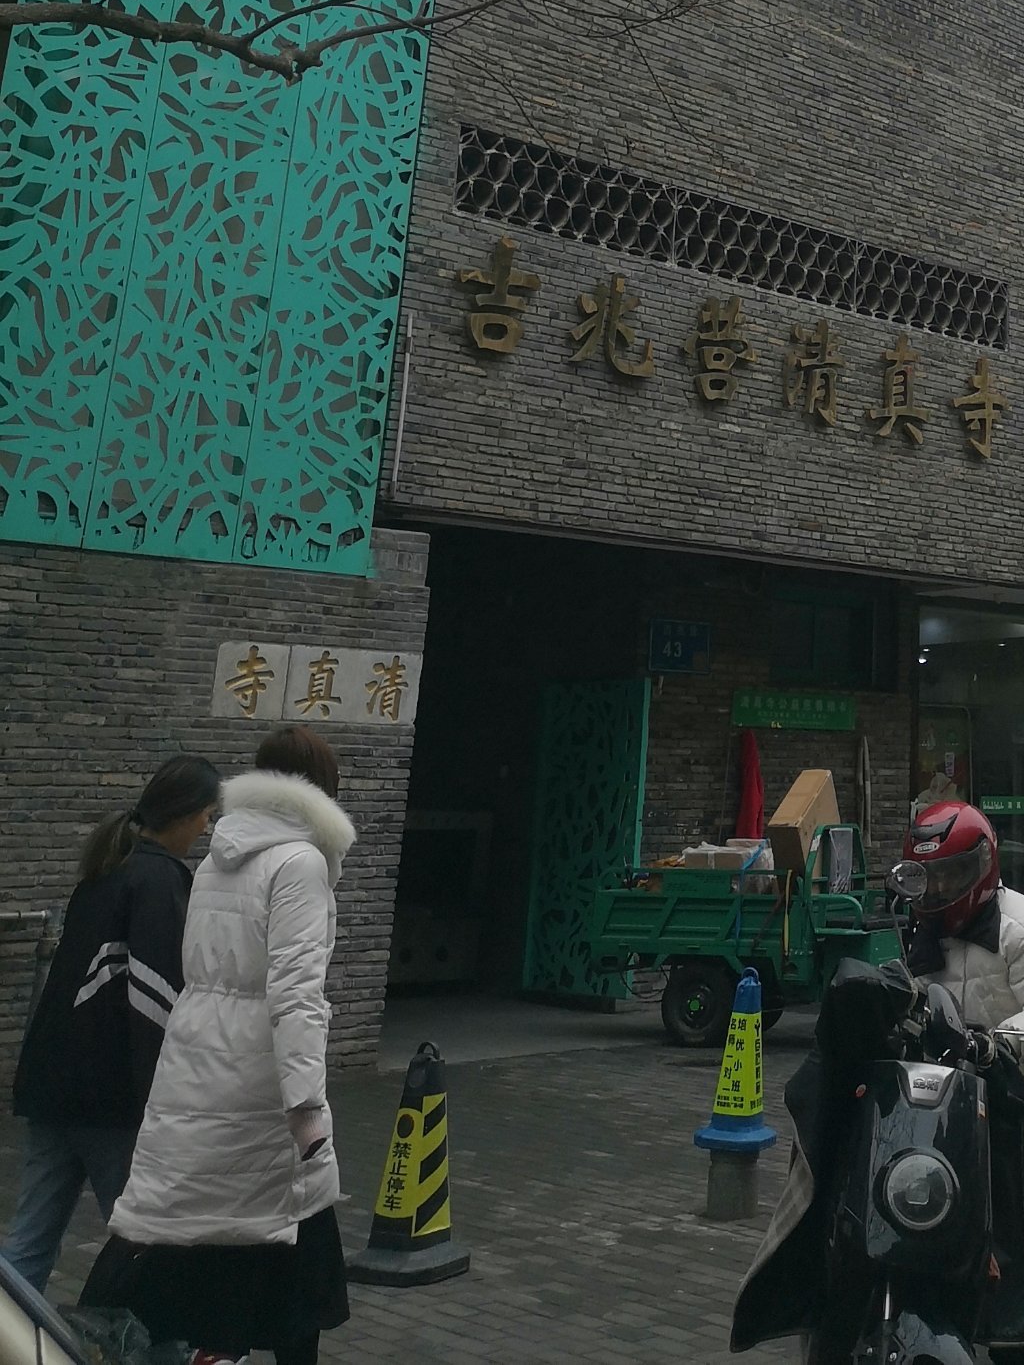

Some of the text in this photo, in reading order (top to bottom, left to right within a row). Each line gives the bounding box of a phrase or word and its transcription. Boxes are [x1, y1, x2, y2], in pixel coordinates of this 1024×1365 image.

[455, 237, 1010, 459] 吉兆营清真寺
[224, 644, 409, 723] 清真寺
[662, 641, 682, 658] 43
[730, 1017, 748, 1093] 培优小班
[383, 1140, 412, 1212] 禁止停车
